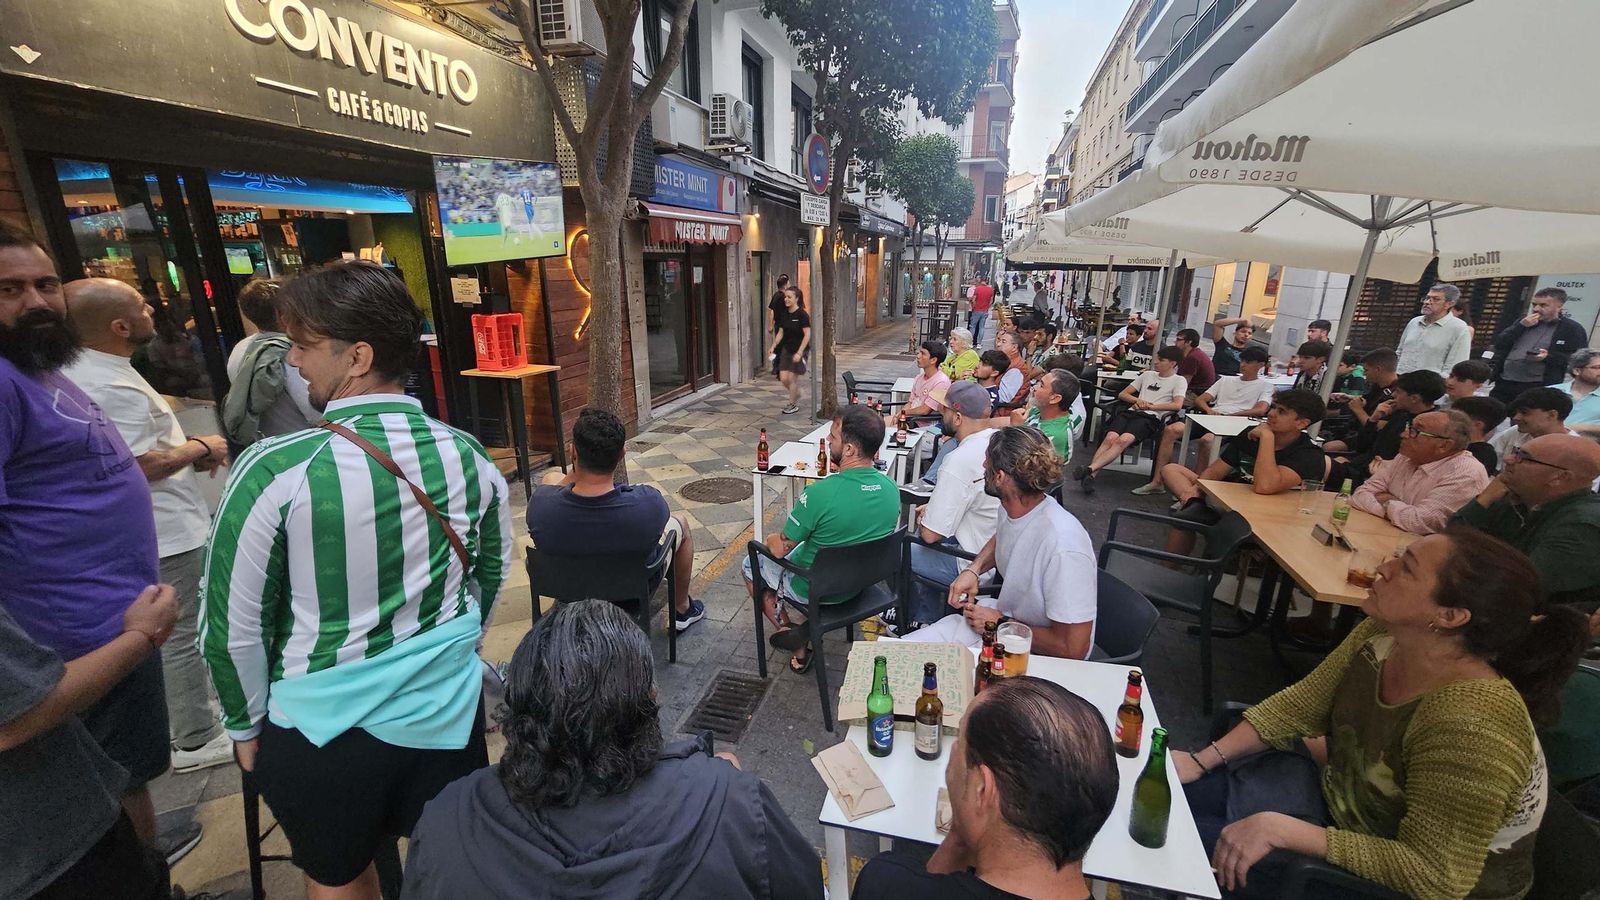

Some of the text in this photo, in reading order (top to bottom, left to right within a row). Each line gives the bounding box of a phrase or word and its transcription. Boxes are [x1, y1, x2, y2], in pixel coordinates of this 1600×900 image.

[224, 0, 479, 105] CONVENTO
[687, 173, 709, 193] MINIT
[675, 221, 730, 241] MISTER MINIT
